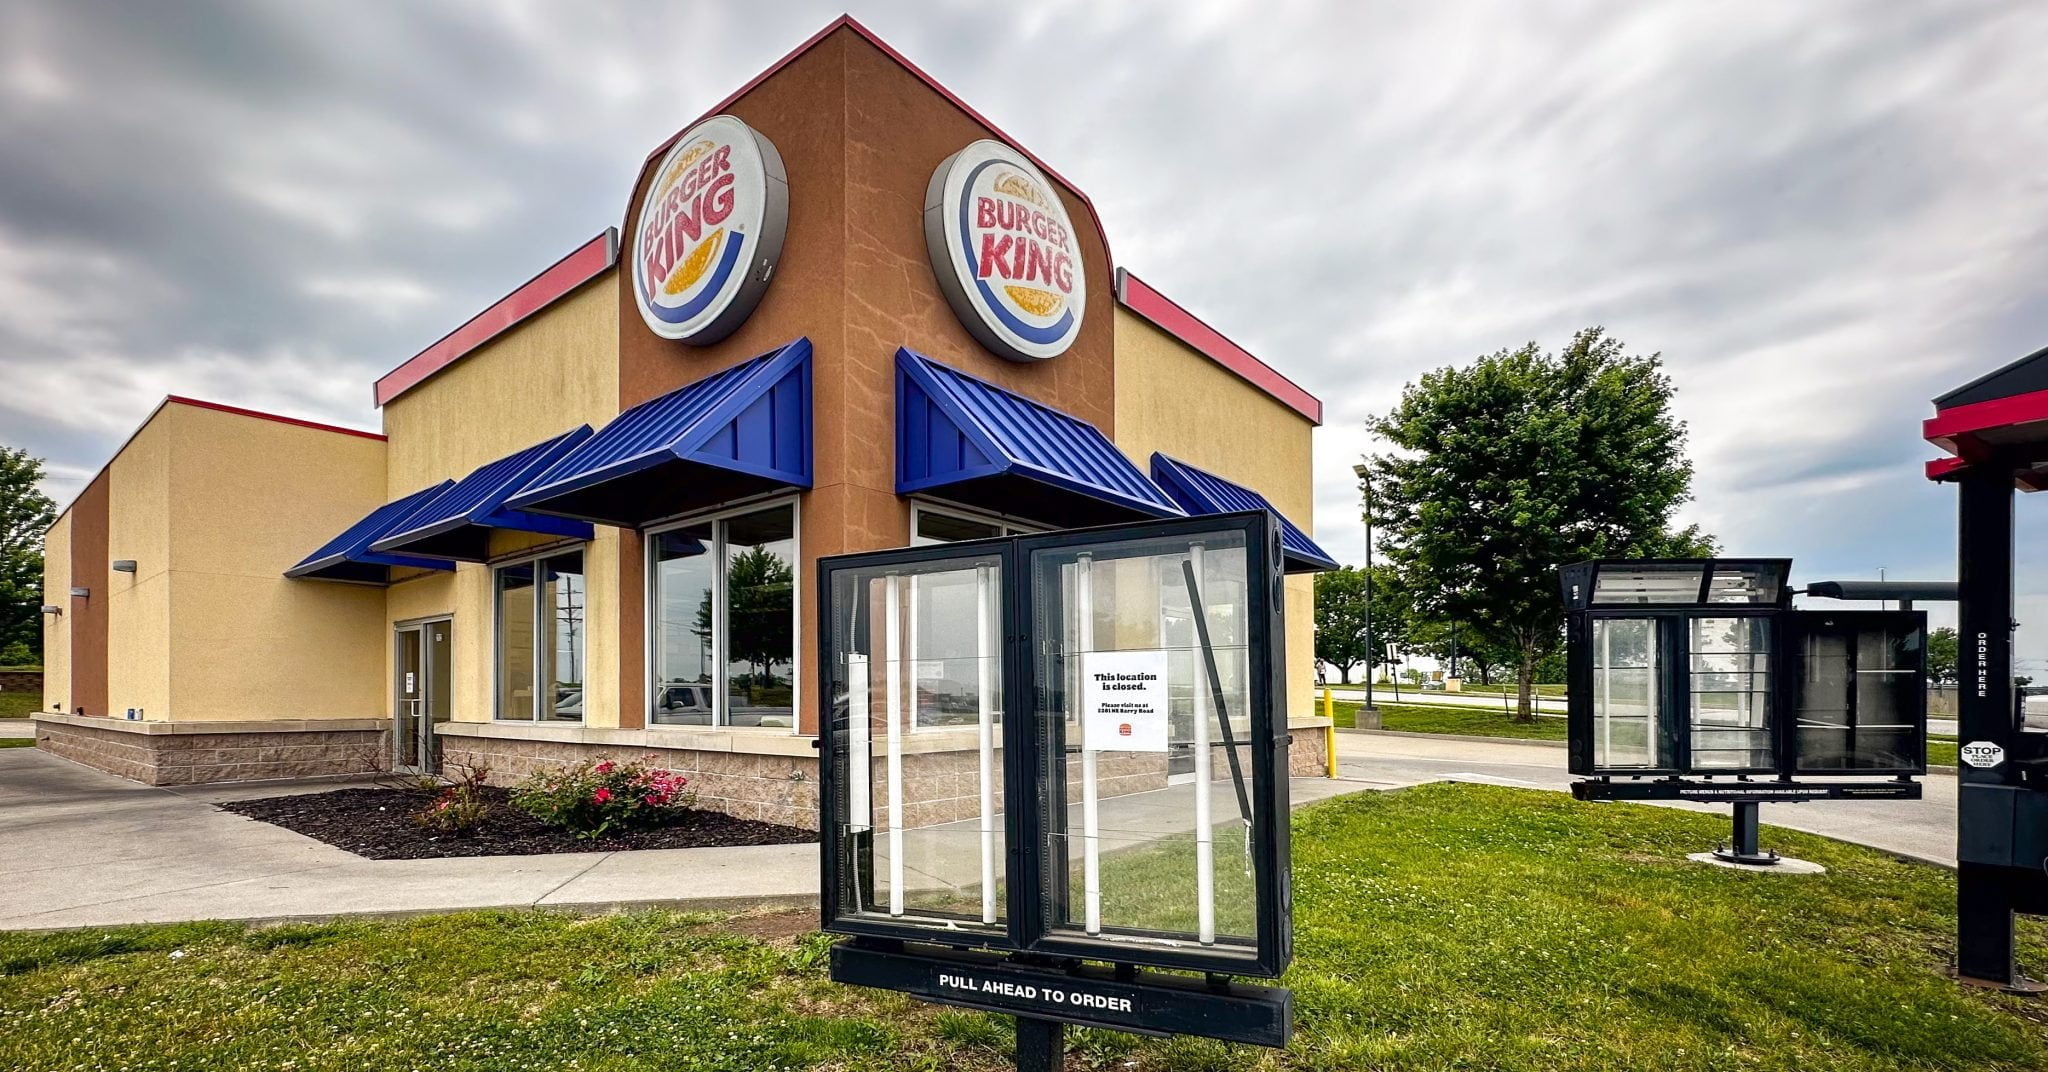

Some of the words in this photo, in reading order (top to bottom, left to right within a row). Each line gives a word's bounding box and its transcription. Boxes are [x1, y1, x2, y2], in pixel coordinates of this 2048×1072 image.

[644, 144, 731, 261] BURGER
[646, 173, 735, 301] KING
[977, 196, 1070, 254] BURGER
[979, 233, 1073, 294] KING
[1977, 632, 1987, 668] ORDER
[1094, 673, 1115, 681] This
[1117, 672, 1157, 681] location
[1102, 682, 1111, 691] is
[1112, 682, 1147, 691] closed.
[1978, 670, 1987, 697] HERE
[1963, 746, 2002, 755] STOP
[939, 974, 978, 991] PULL
[982, 980, 1037, 999] AHEAD
[1041, 988, 1065, 1003] TO
[1070, 992, 1132, 1012] ORDER
